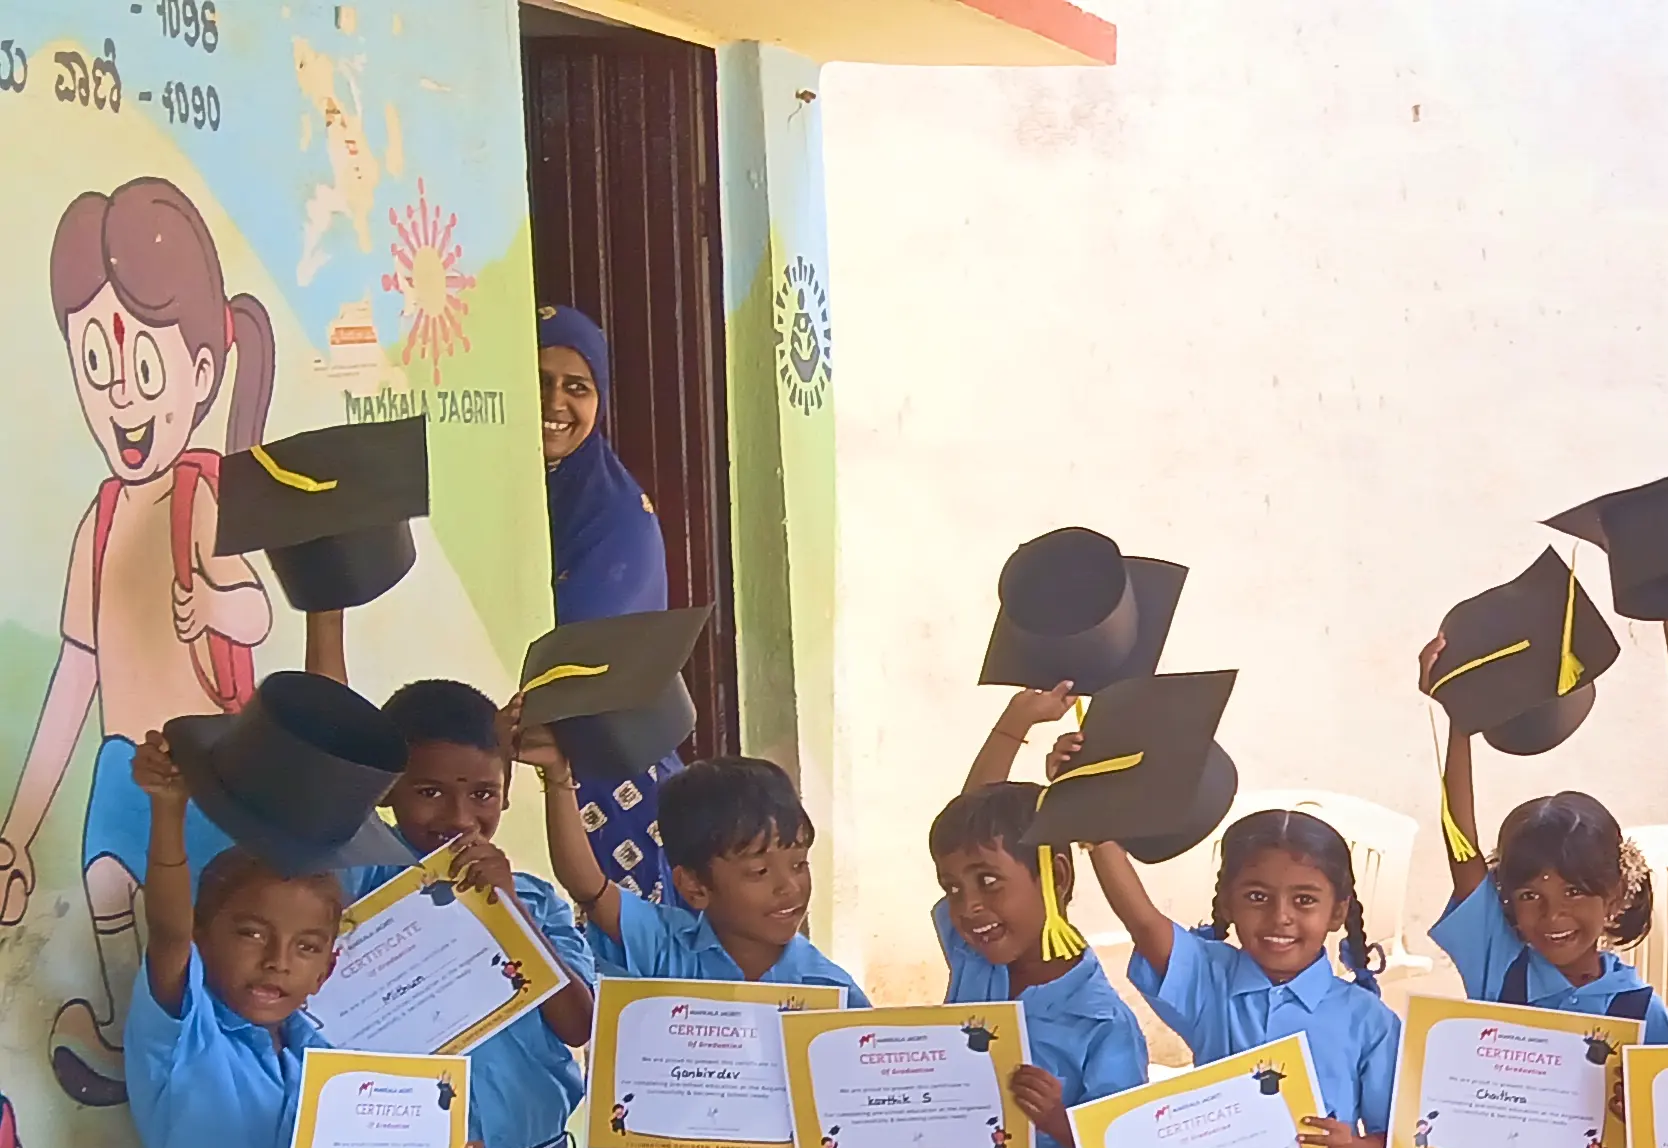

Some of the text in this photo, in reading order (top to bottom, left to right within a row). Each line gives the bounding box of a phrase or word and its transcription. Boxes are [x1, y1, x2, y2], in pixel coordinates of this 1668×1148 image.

[162, 81, 220, 131] 1090
[437, 390, 505, 425] JAGRITI
[340, 921, 421, 978] CERTIFICATE
[668, 1024, 758, 1038] CERTIFICATE
[859, 1049, 946, 1064] CERTIFICATE
[1476, 1046, 1561, 1065] CERTIFICATE
[1505, 1065, 1546, 1075] Graduation
[921, 1091, 931, 1103] S
[355, 1103, 421, 1116] CERTIFICATE
[1157, 1102, 1241, 1138] CERTIFICATE
